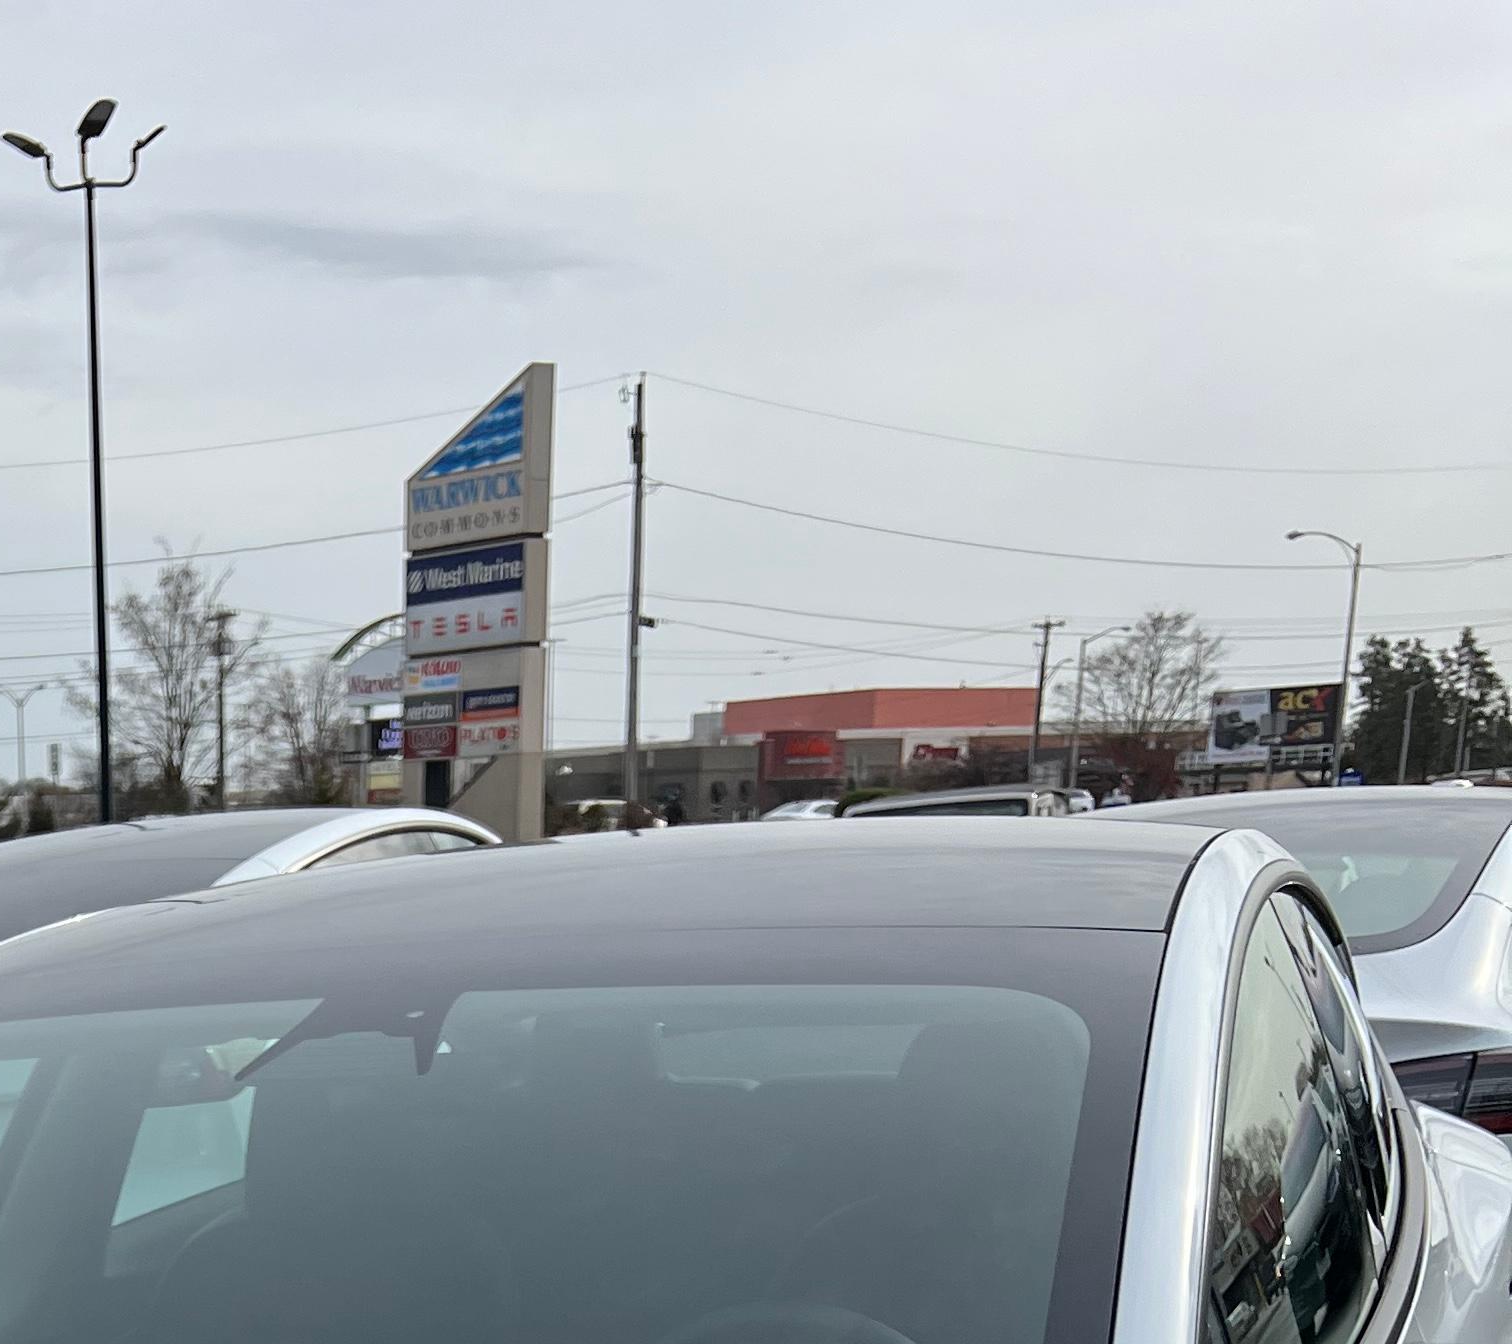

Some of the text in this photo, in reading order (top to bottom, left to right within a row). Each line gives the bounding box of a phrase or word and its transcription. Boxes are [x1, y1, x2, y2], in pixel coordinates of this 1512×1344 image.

[411, 470, 523, 513] WARWICK
[411, 506, 520, 540] COMMONS
[424, 557, 524, 592] West Marine
[409, 607, 519, 640] TESLA
